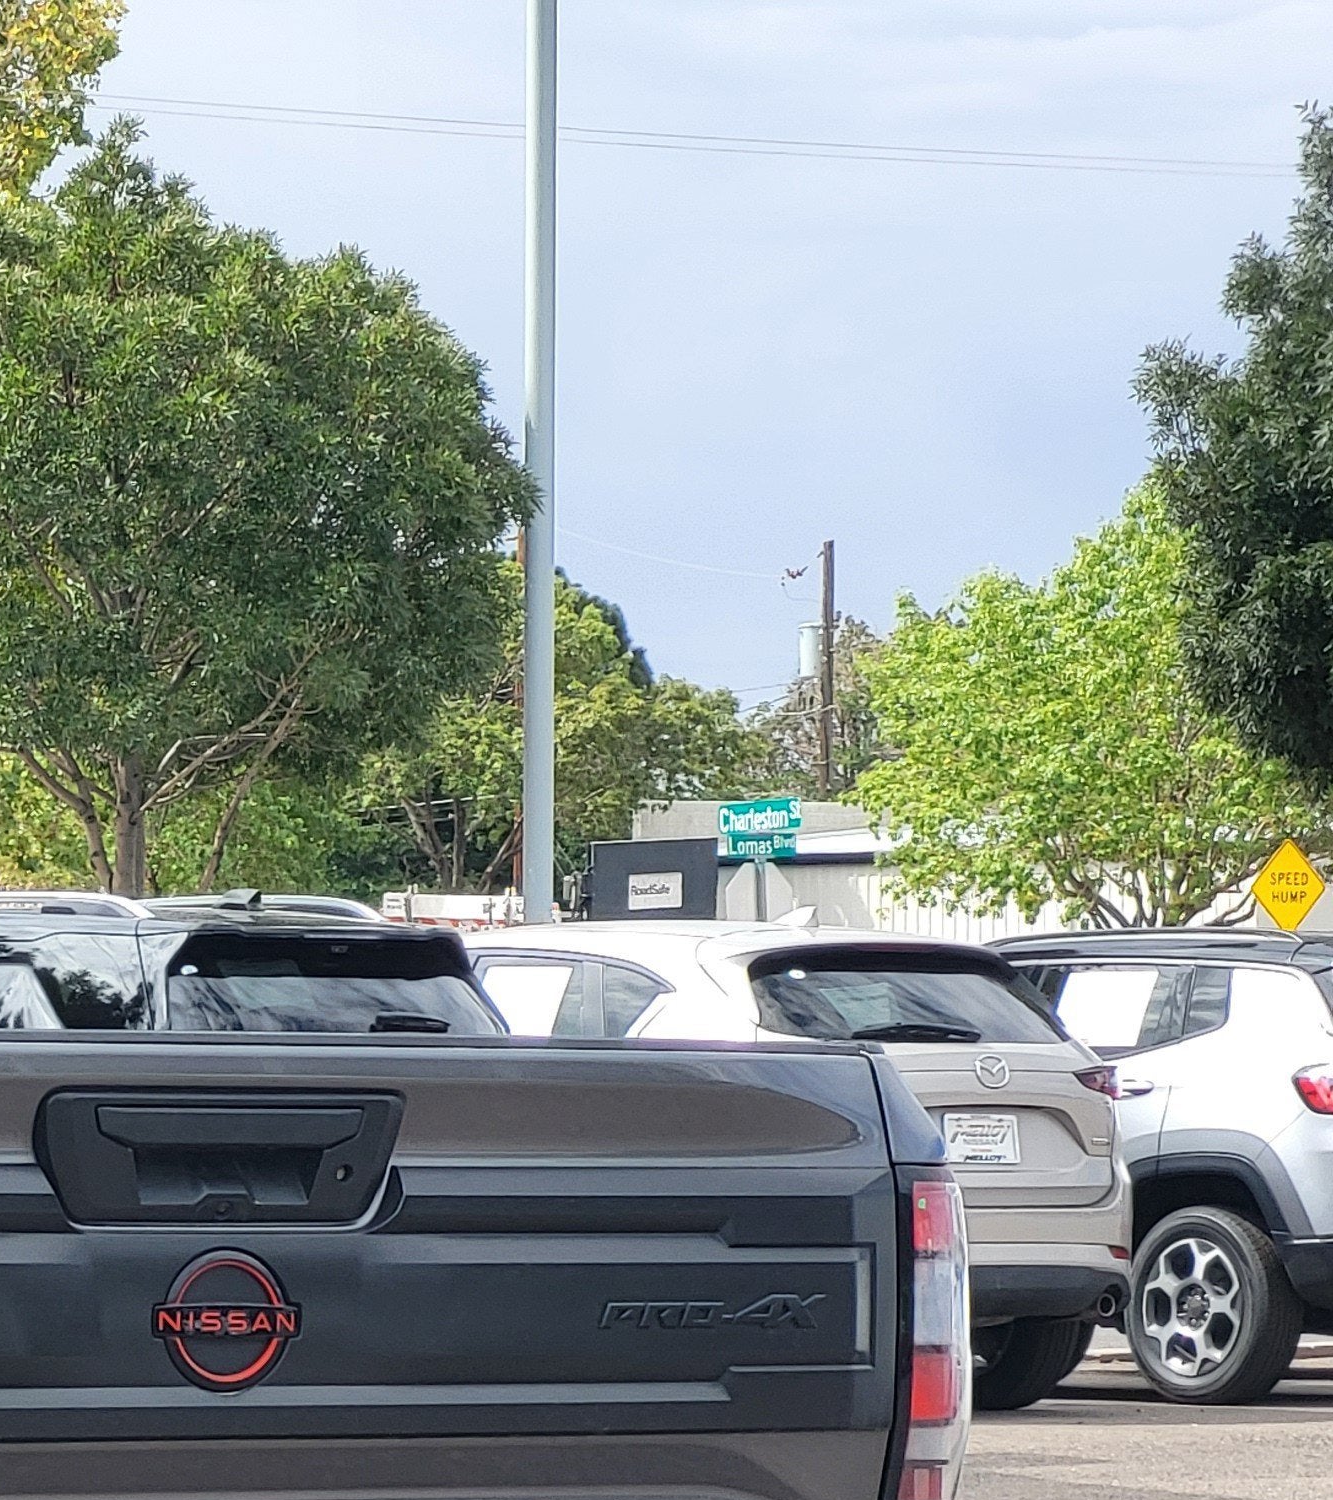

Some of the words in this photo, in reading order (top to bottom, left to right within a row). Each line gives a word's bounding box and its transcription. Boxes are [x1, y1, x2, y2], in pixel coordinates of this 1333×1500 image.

[719, 807, 788, 833] Charleston
[789, 800, 801, 819] St
[729, 837, 772, 855] Lomas
[773, 835, 796, 849] Blvd
[1270, 872, 1309, 886] SPEED
[1272, 891, 1307, 904] HUMP
[157, 1309, 296, 1333] NISSAN
